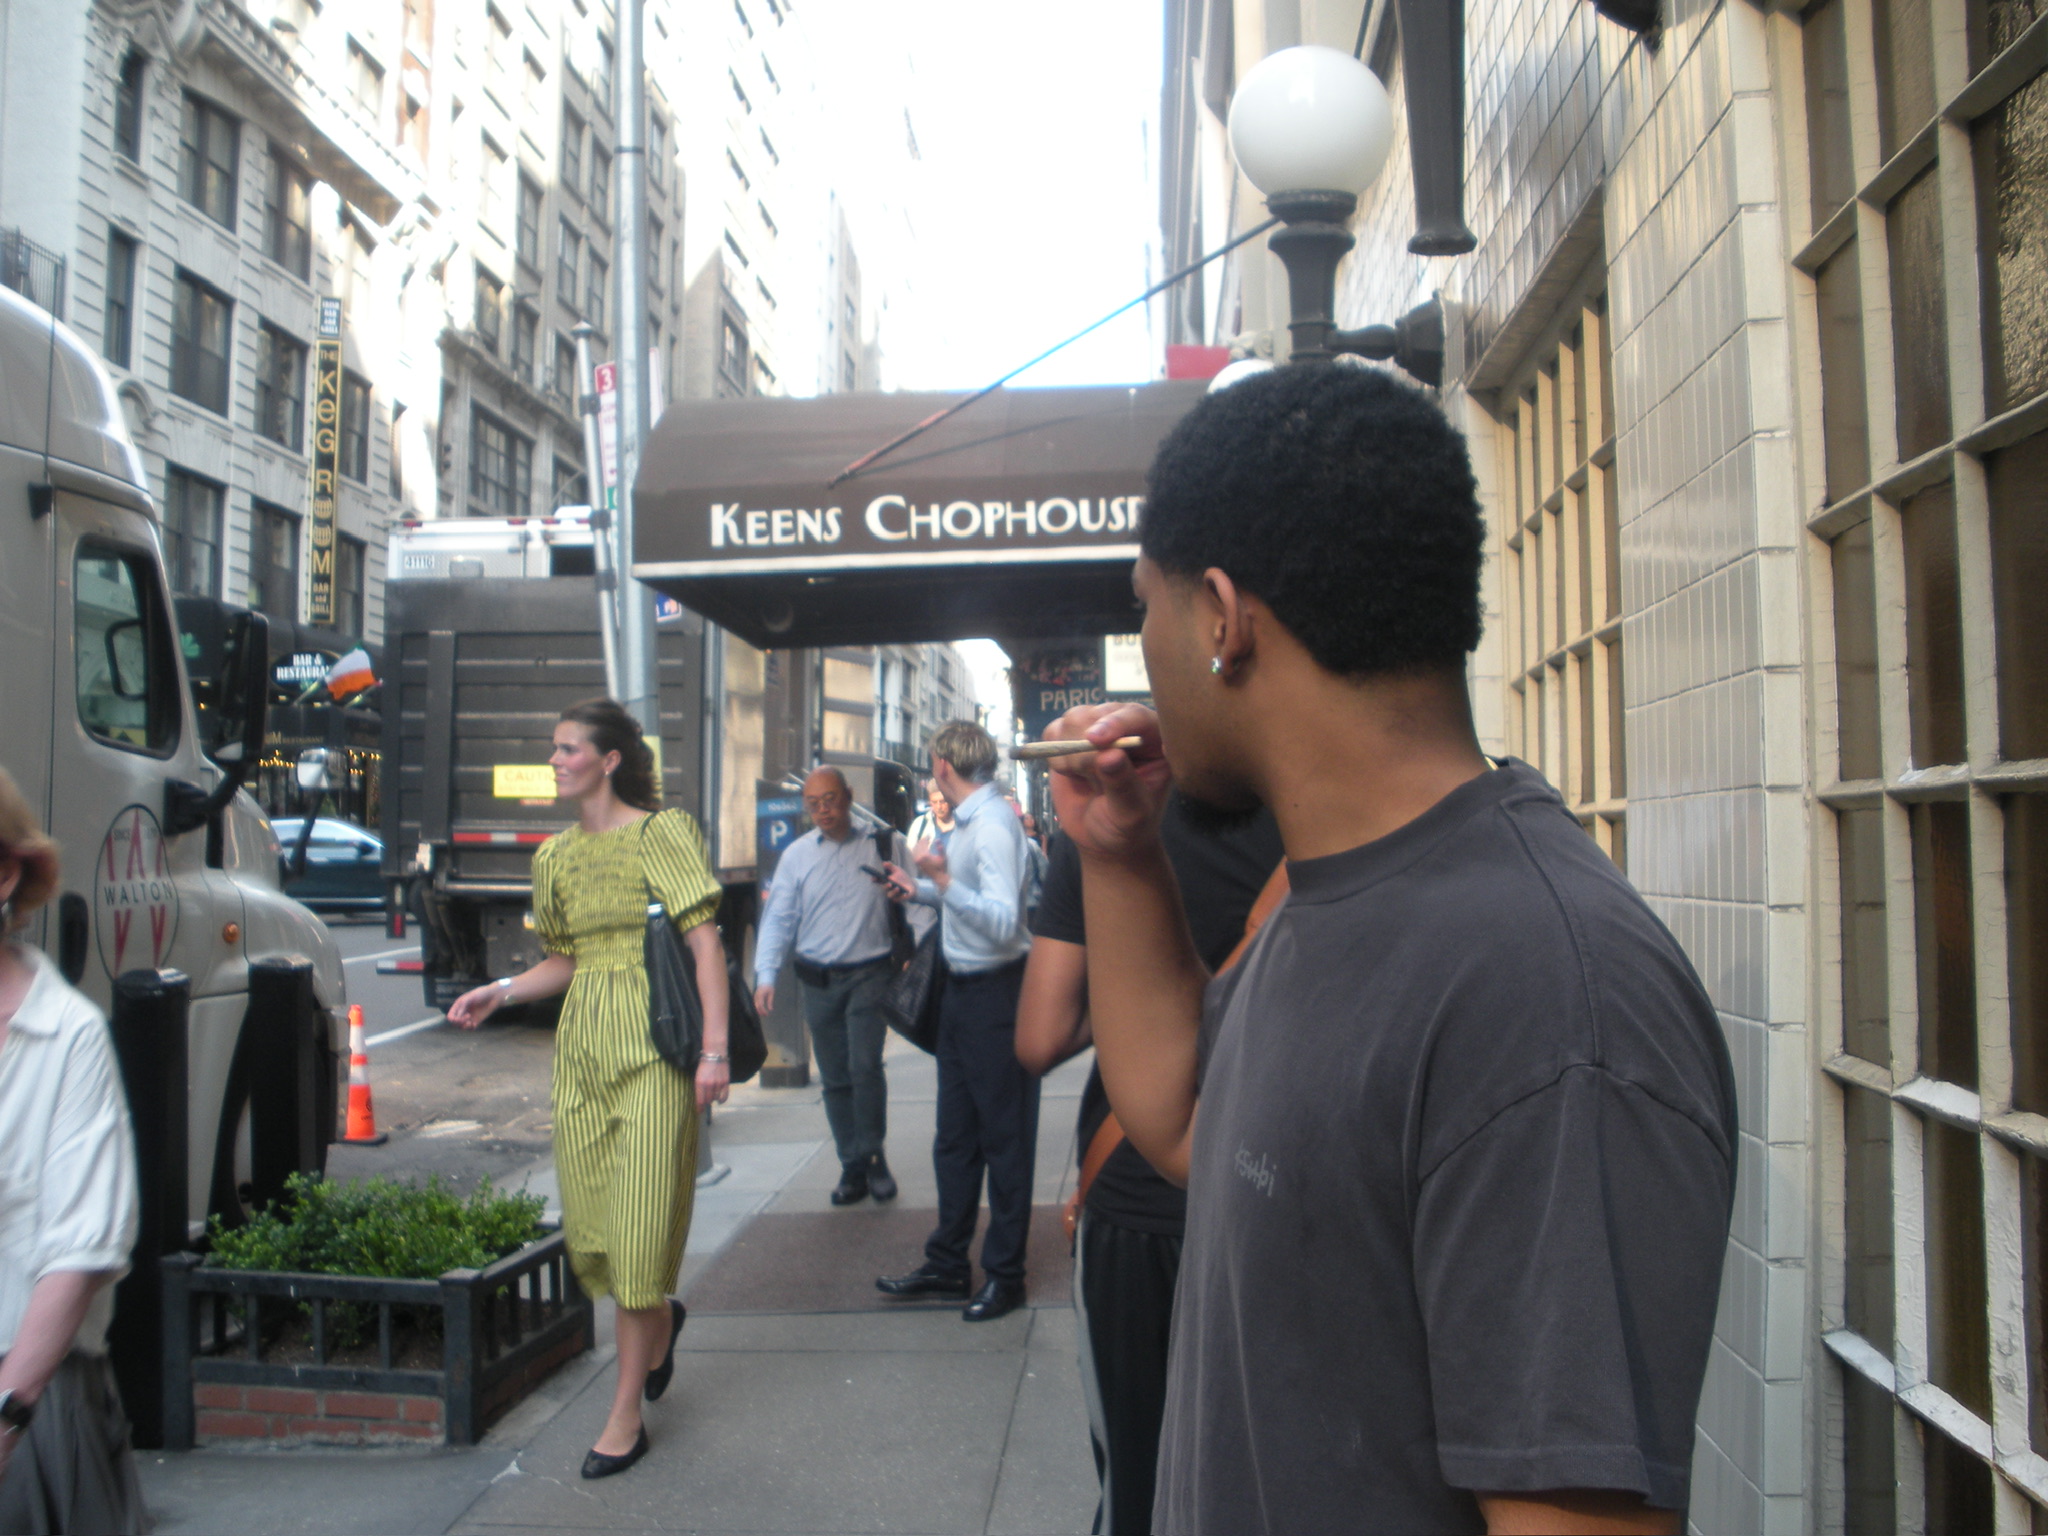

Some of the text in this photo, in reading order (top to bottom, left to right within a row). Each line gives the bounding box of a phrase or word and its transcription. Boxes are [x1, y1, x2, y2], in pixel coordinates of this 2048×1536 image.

[320, 350, 338, 360] THE
[601, 367, 614, 391] 3
[710, 503, 842, 547] KEENS
[293, 653, 322, 666] BAR &
[277, 666, 329, 680] RESTAURA
[770, 820, 788, 846] P
[104, 880, 173, 906] WALTON
